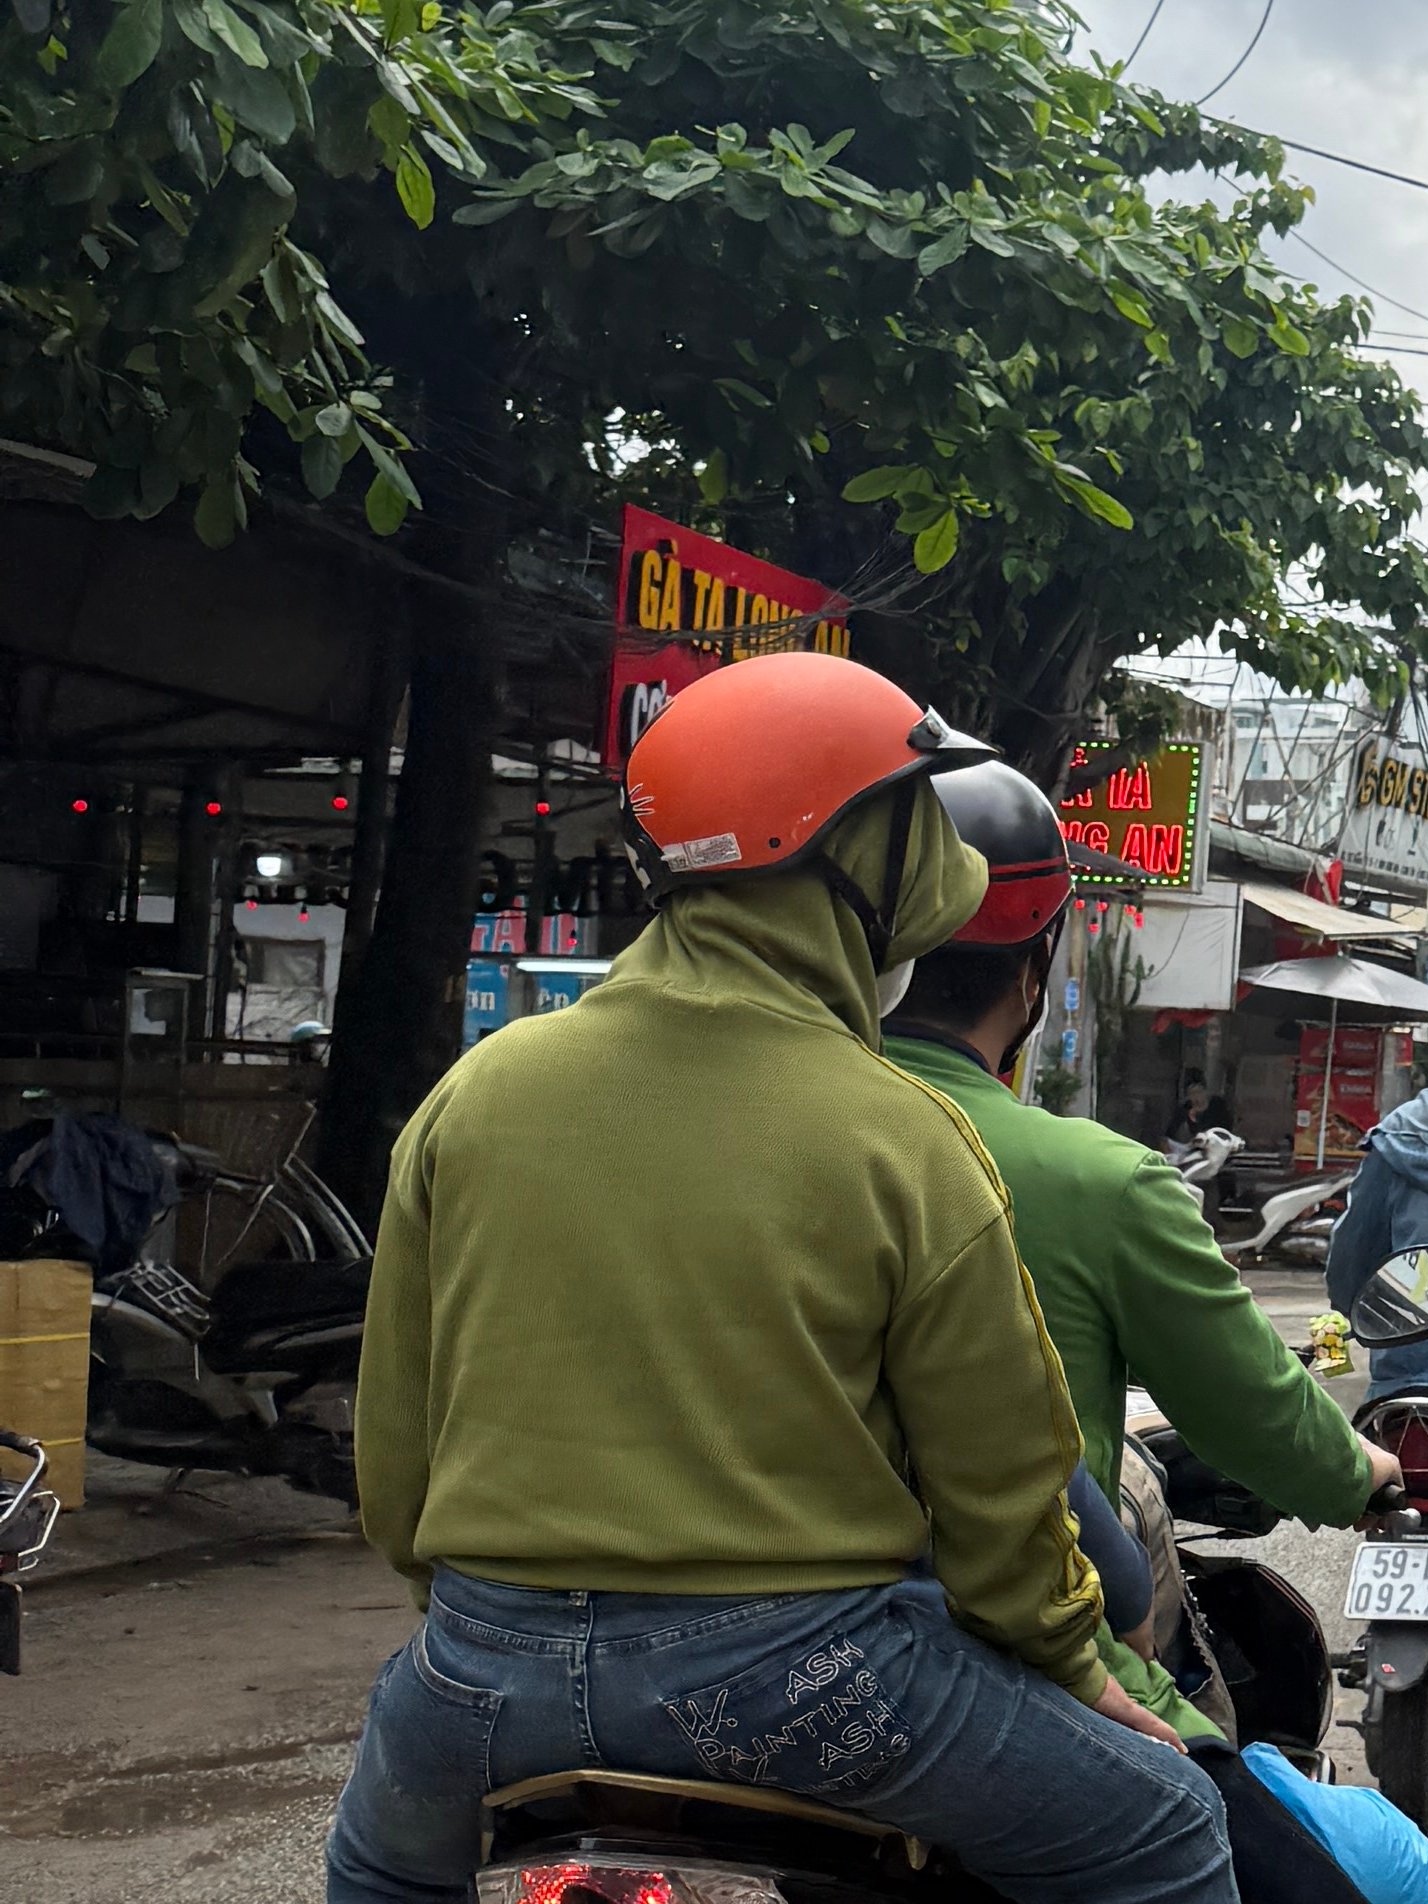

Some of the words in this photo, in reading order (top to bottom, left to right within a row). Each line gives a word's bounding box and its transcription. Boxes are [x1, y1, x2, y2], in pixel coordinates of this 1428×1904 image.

[639, 539, 682, 632] GÀ
[1121, 824, 1184, 874] AN
[786, 1638, 864, 1705] ASH
[694, 1670, 879, 1772] PAINTING
[819, 1700, 899, 1772] ASH
